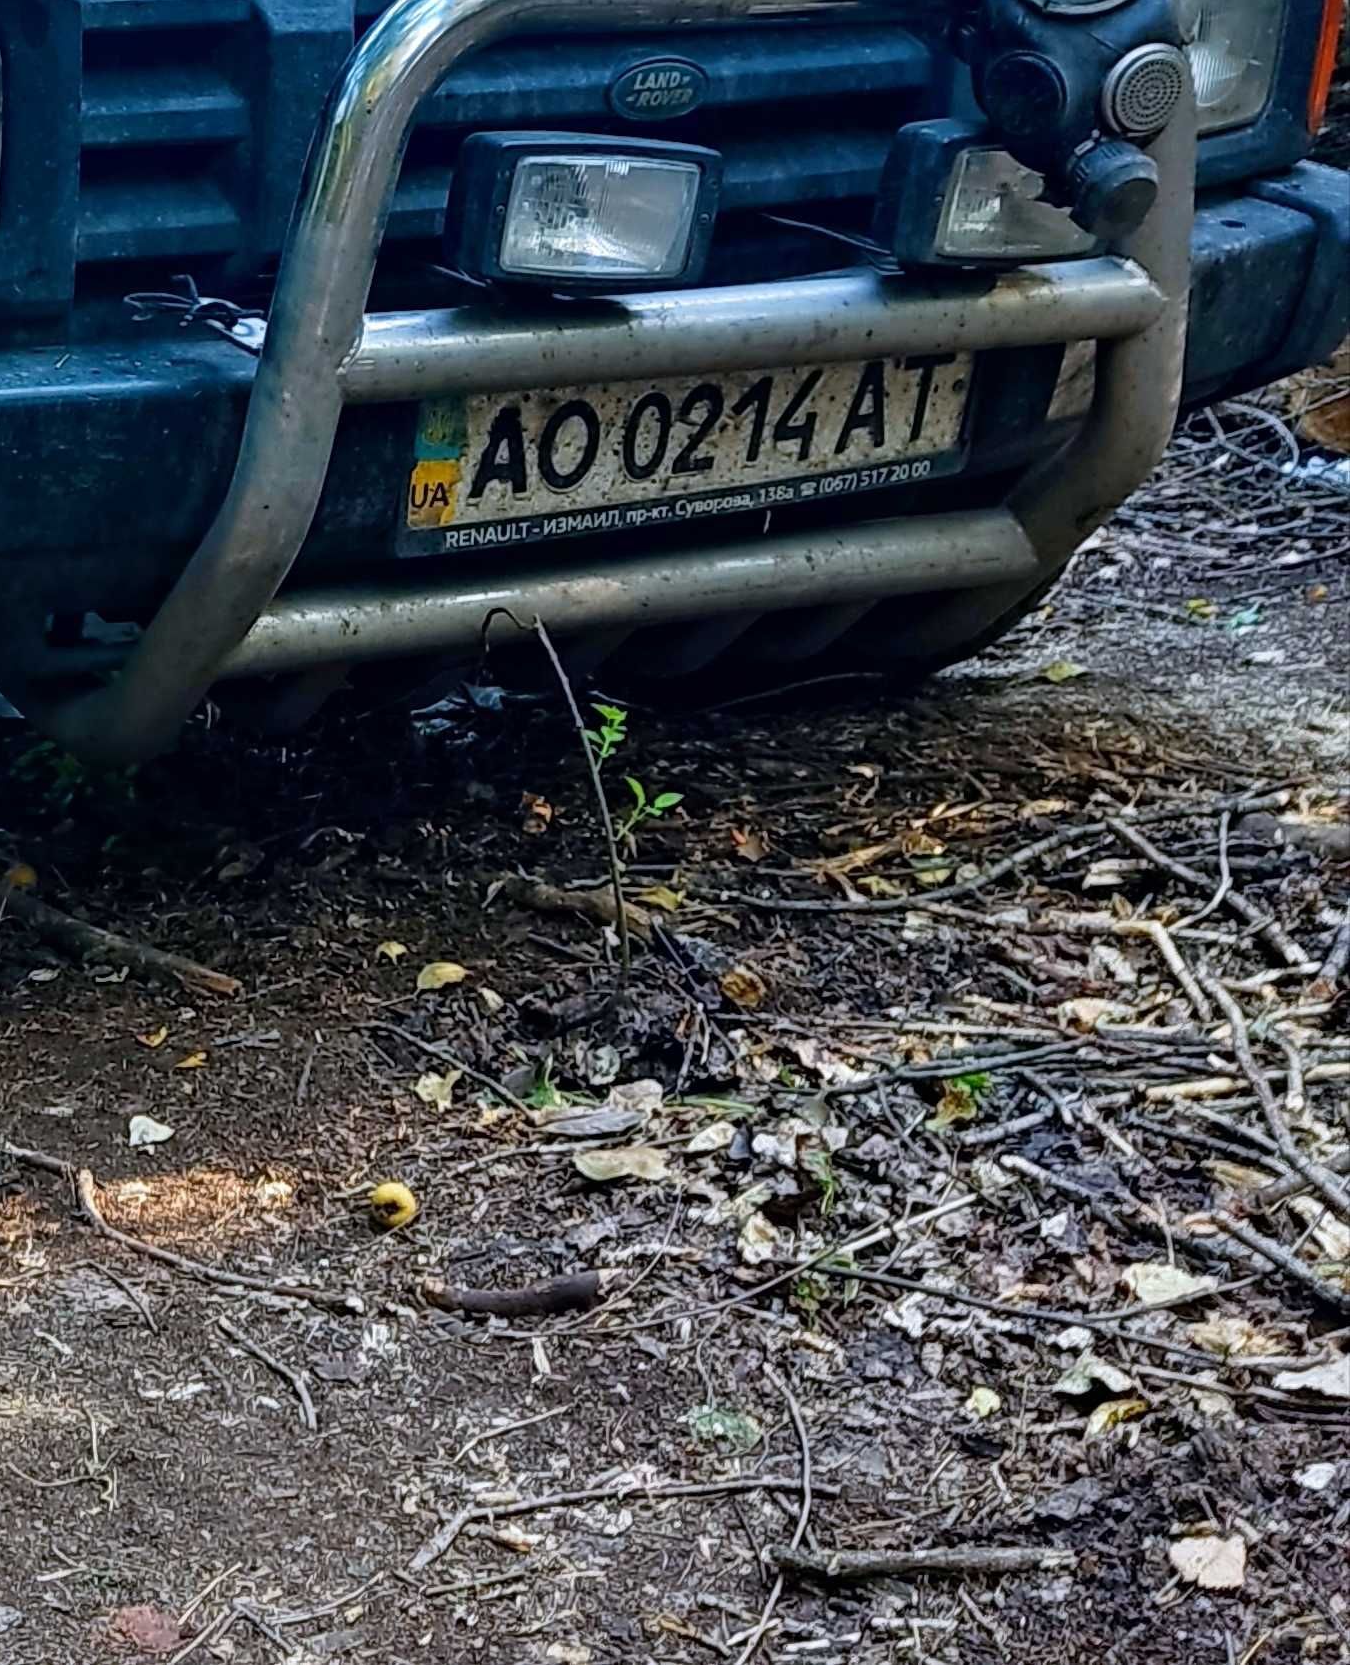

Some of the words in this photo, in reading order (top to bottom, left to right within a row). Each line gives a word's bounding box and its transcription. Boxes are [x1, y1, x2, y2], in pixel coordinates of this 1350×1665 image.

[633, 71, 681, 90] LAND
[635, 89, 694, 107] ROVER
[411, 482, 449, 509] UA
[445, 522, 531, 548] RENAULT
[542, 509, 623, 536] ИЗМАИЛ,
[819, 472, 858, 494] (067)
